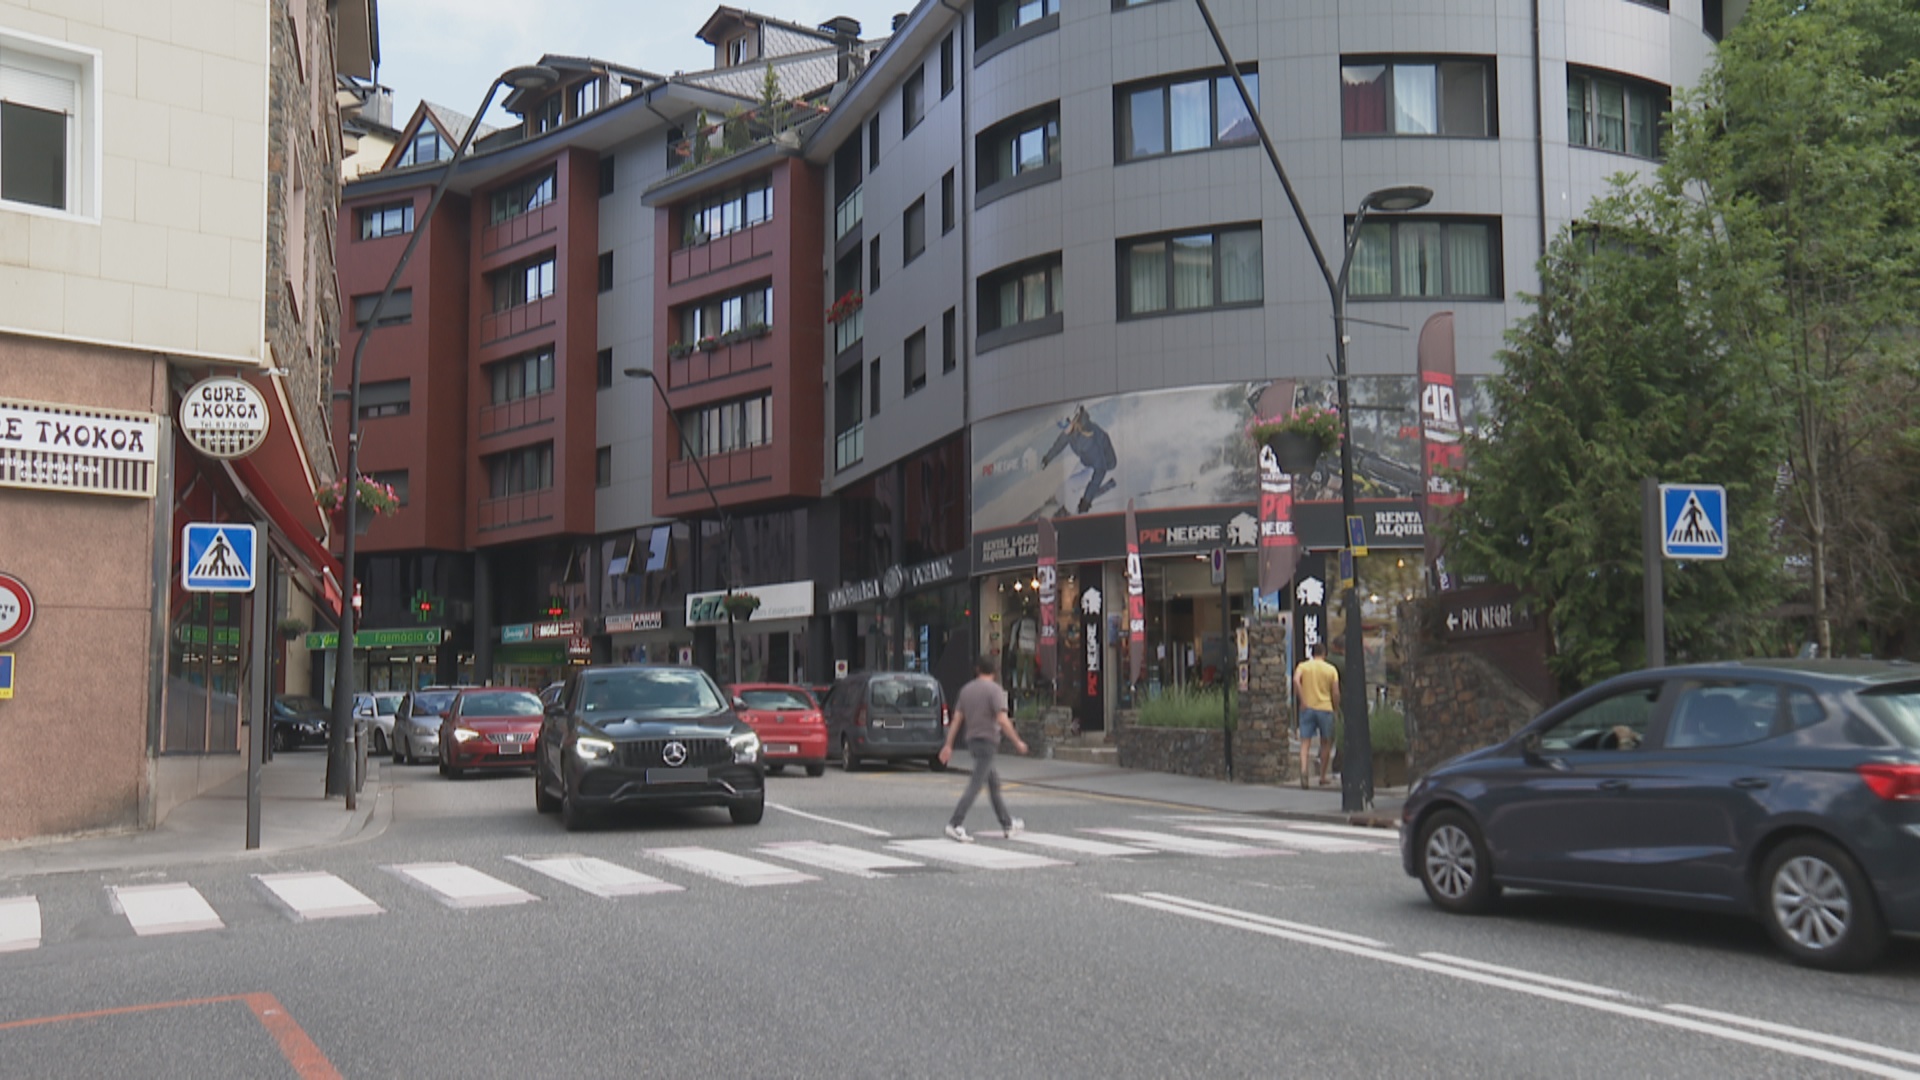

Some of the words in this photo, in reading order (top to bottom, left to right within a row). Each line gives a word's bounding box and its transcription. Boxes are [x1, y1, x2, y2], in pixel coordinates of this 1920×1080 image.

[202, 386, 246, 401] GURE
[191, 402, 258, 418] TXOKOA
[1422, 384, 1457, 421] 40
[36, 420, 145, 452] TXOKOA
[1375, 511, 1422, 524] RENTA
[1167, 525, 1222, 541] NEGRE
[1261, 521, 1294, 536] NEGRE
[1482, 603, 1513, 629] NEGRE
